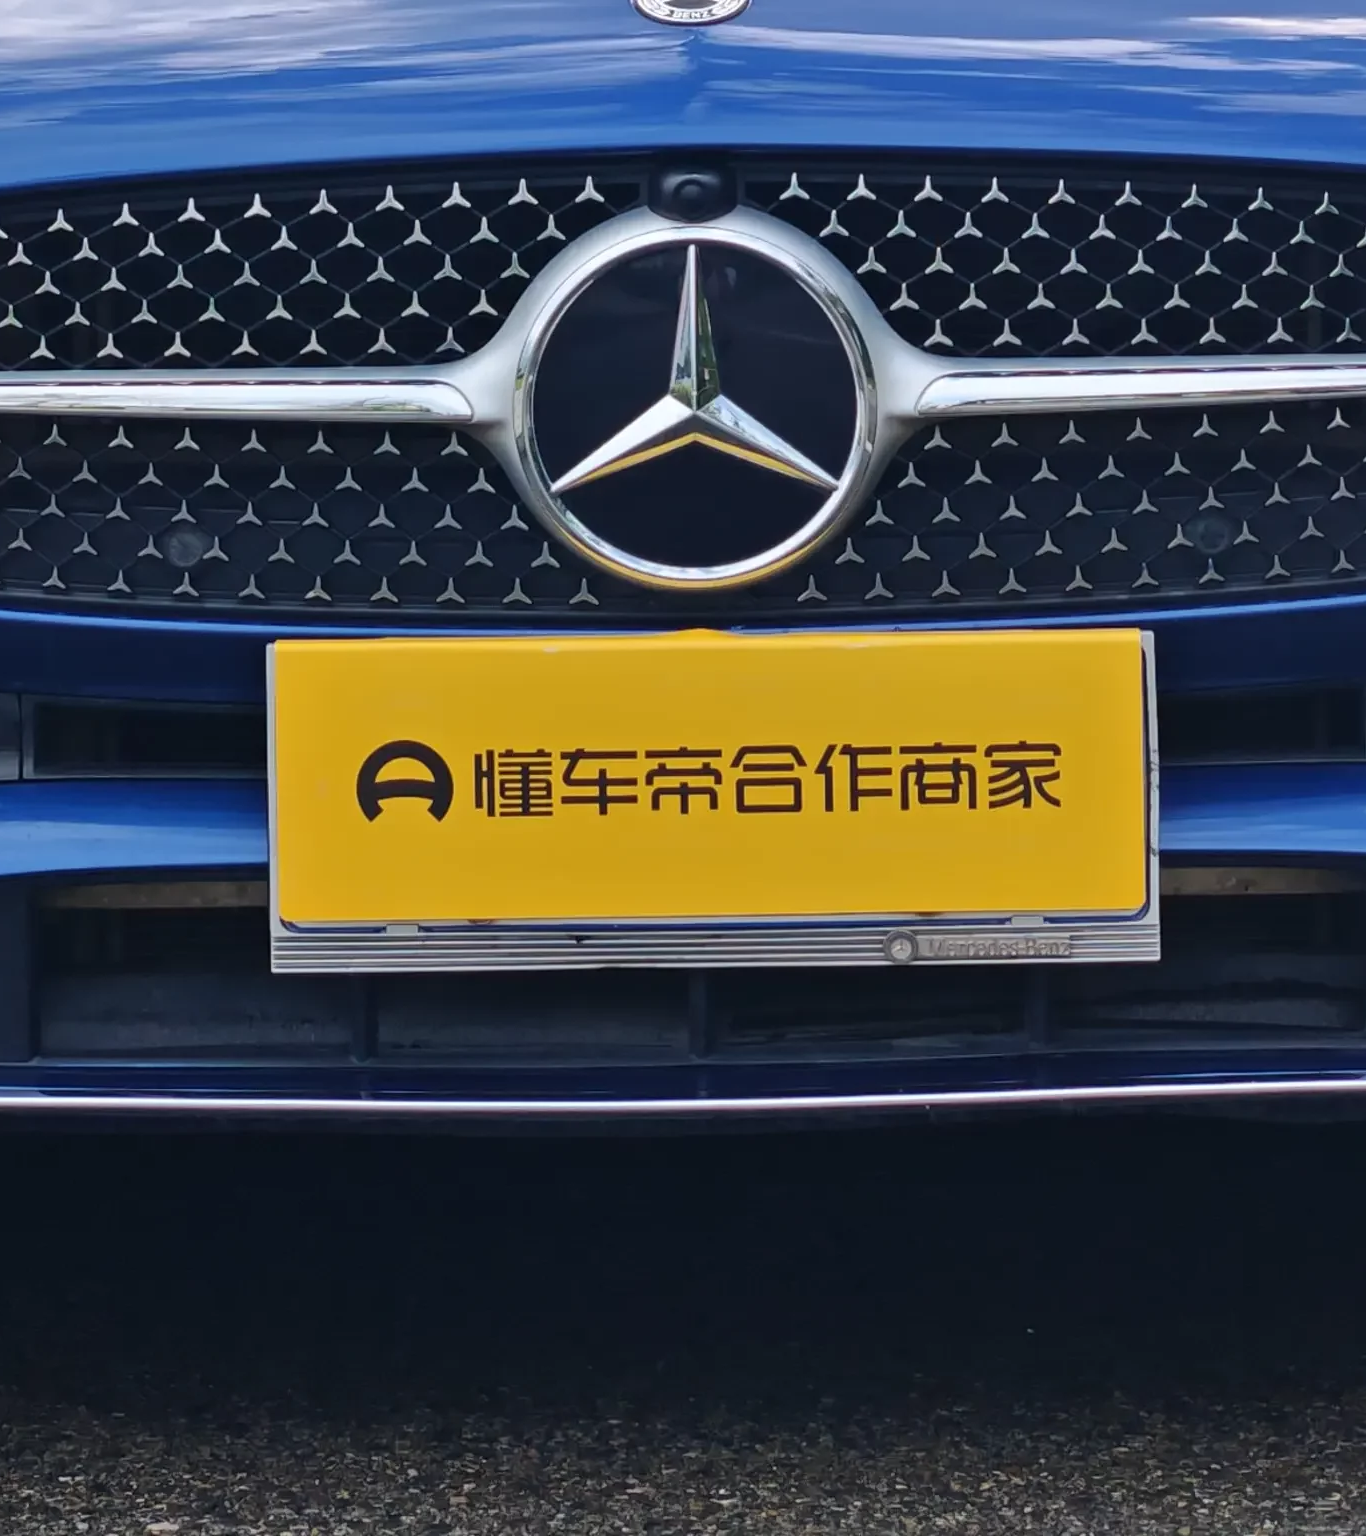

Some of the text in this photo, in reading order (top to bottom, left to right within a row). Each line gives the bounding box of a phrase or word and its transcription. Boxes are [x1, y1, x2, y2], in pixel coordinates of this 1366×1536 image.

[473, 740, 1062, 817] 懂车帝合作商家
[927, 936, 1072, 957] Mercedes-Benz
